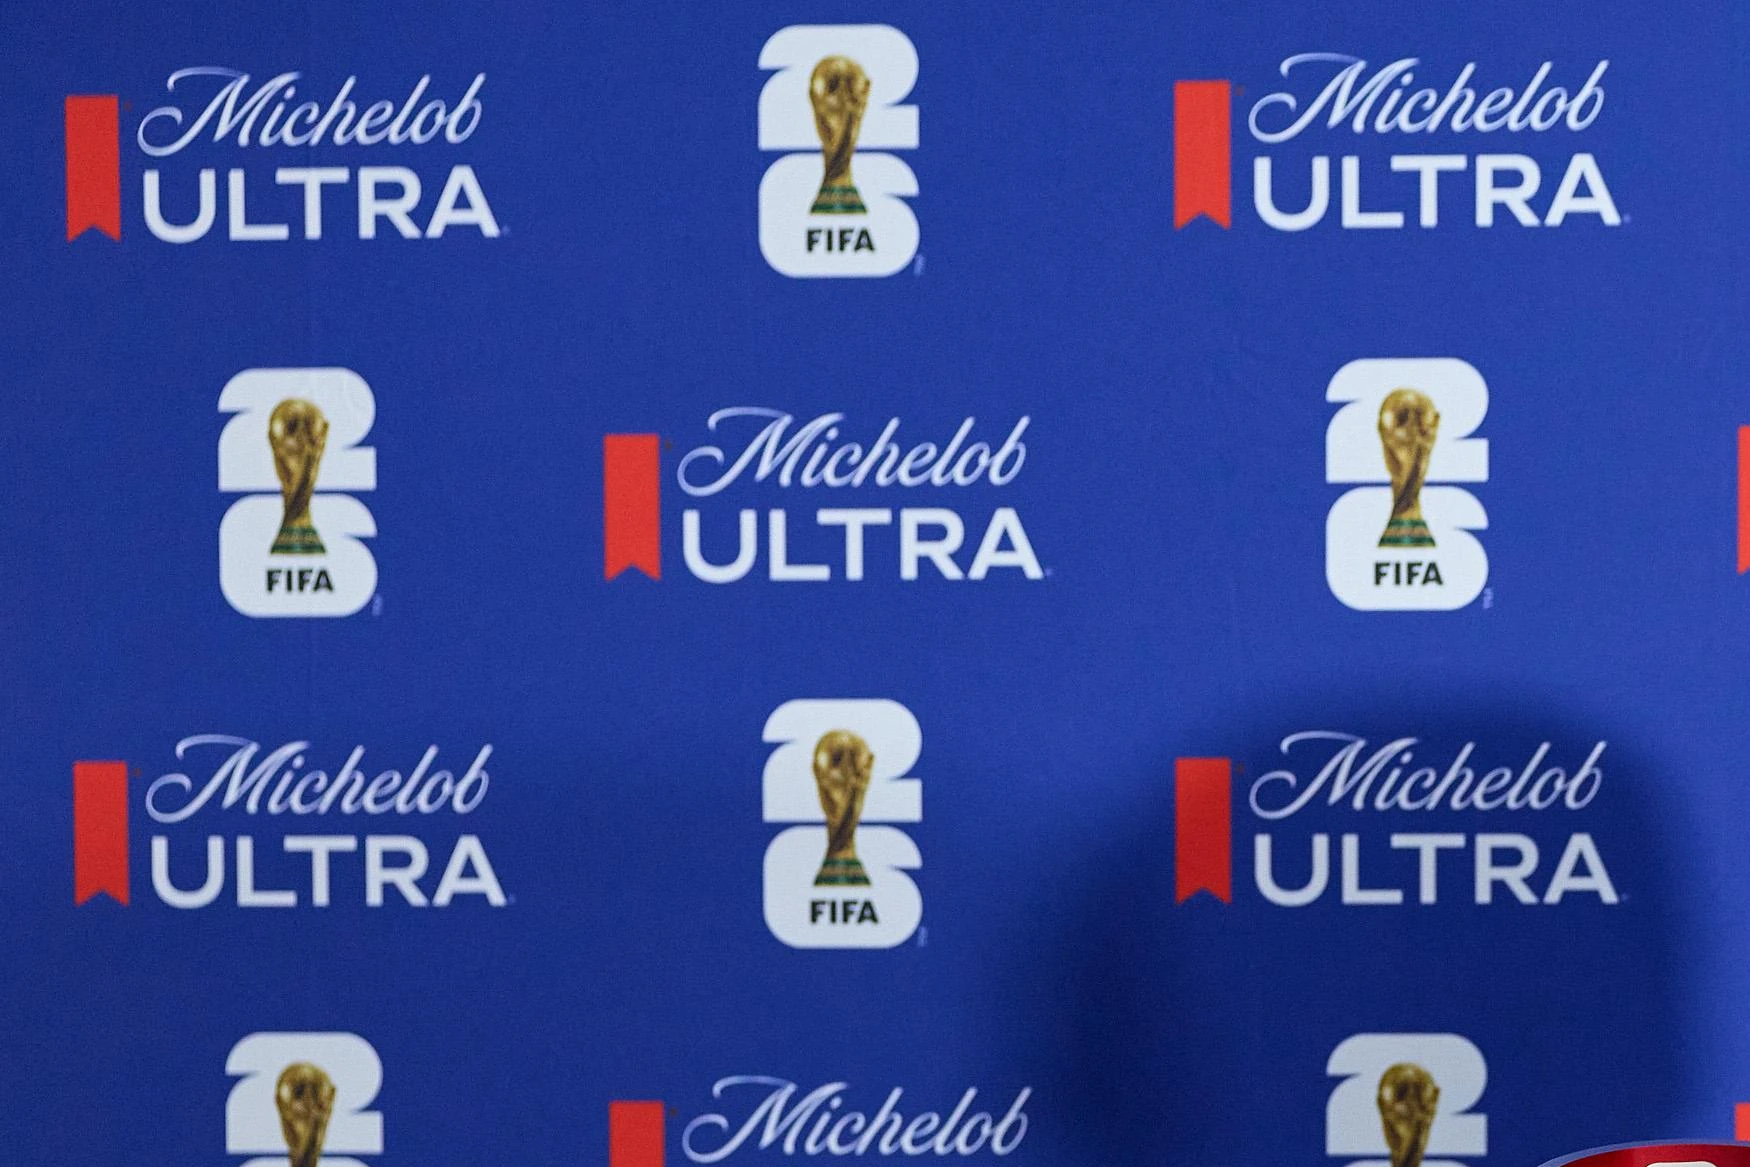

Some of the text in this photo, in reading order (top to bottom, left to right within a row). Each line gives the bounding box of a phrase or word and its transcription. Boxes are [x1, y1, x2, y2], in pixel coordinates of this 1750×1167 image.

[138, 68, 485, 156] Michelob
[1249, 53, 1608, 142] Michelob
[143, 165, 500, 243] ULTRA
[1254, 153, 1620, 231] ULTRA
[806, 227, 876, 253] FIFA
[678, 408, 1029, 496] Michelob
[266, 567, 335, 593] FIFA
[683, 508, 1043, 583] ULTRA
[1374, 561, 1444, 586] FIFA
[146, 735, 492, 822] Michelob
[1250, 731, 1606, 819] Michelob
[152, 835, 506, 908] ULTRA
[1255, 833, 1616, 906] ULTRA
[810, 899, 880, 924] FIFA
[683, 1077, 1030, 1163] Michelob
